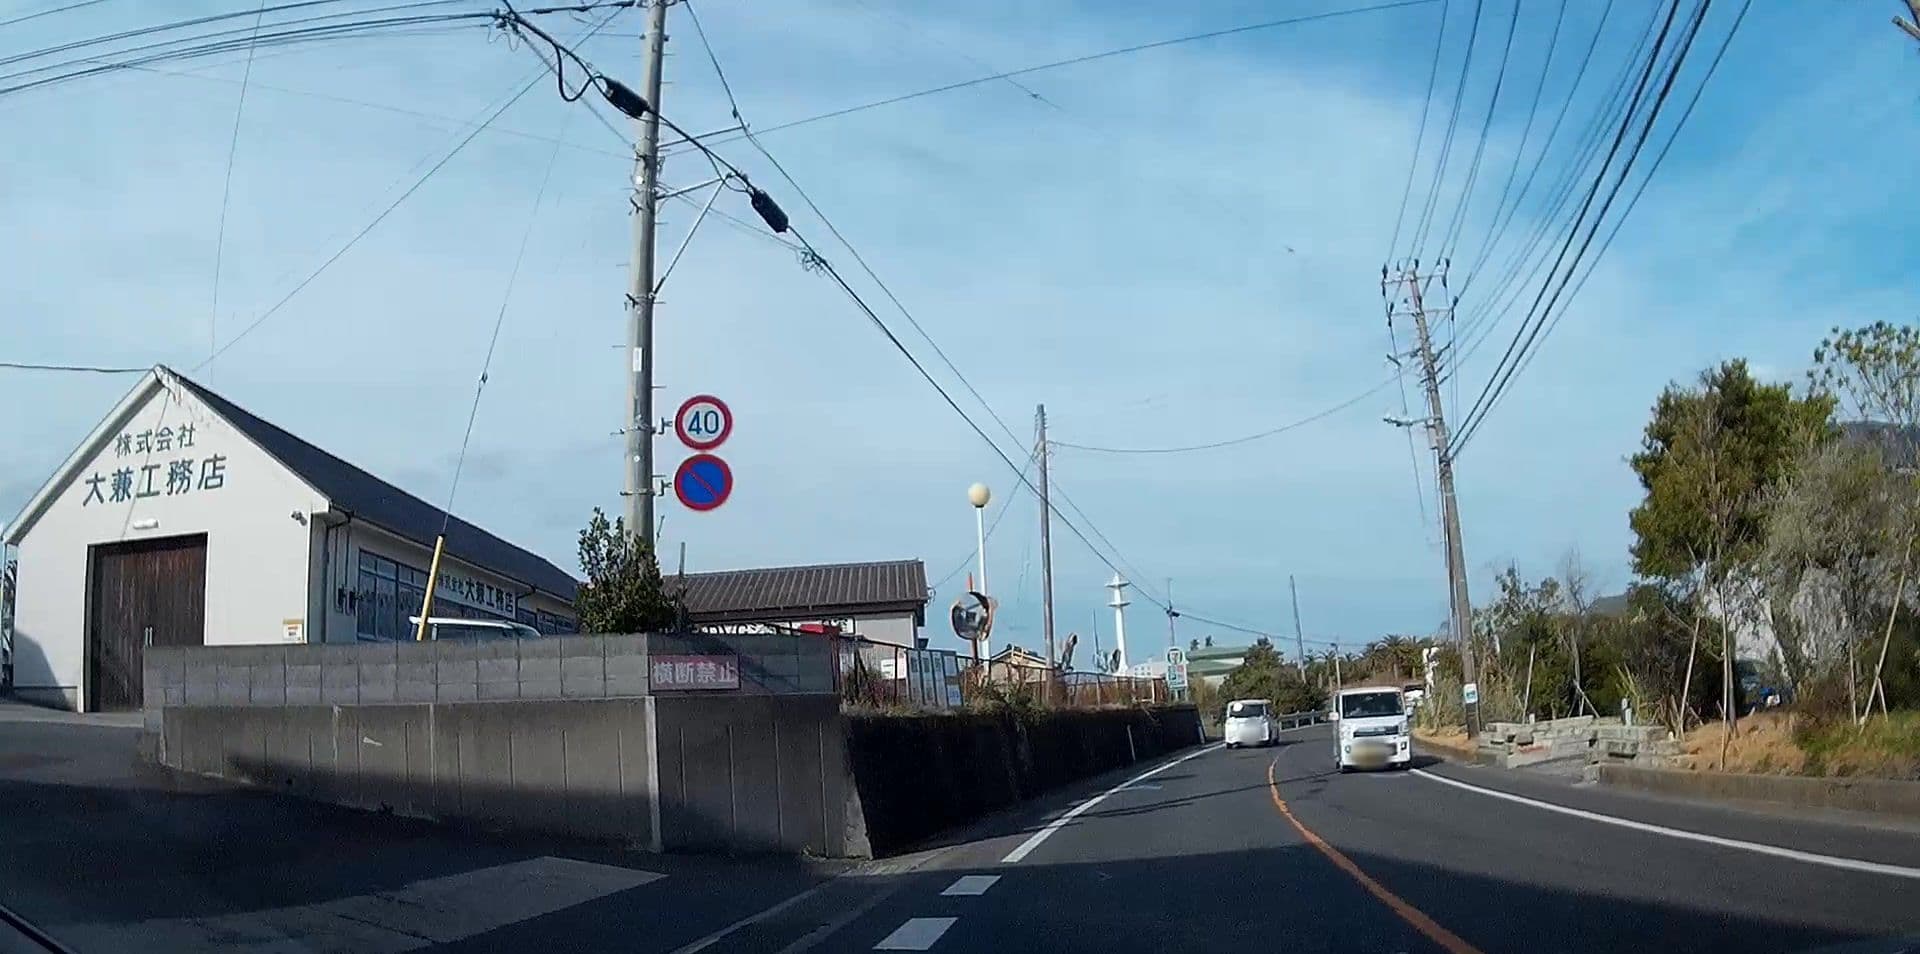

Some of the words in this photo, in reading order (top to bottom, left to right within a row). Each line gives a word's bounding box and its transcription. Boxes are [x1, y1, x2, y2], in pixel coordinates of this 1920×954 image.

[688, 410, 719, 434] 40
[115, 422, 196, 458] 株式会社
[82, 453, 227, 507] 大兼工務店
[653, 661, 739, 684] 横断禁止
